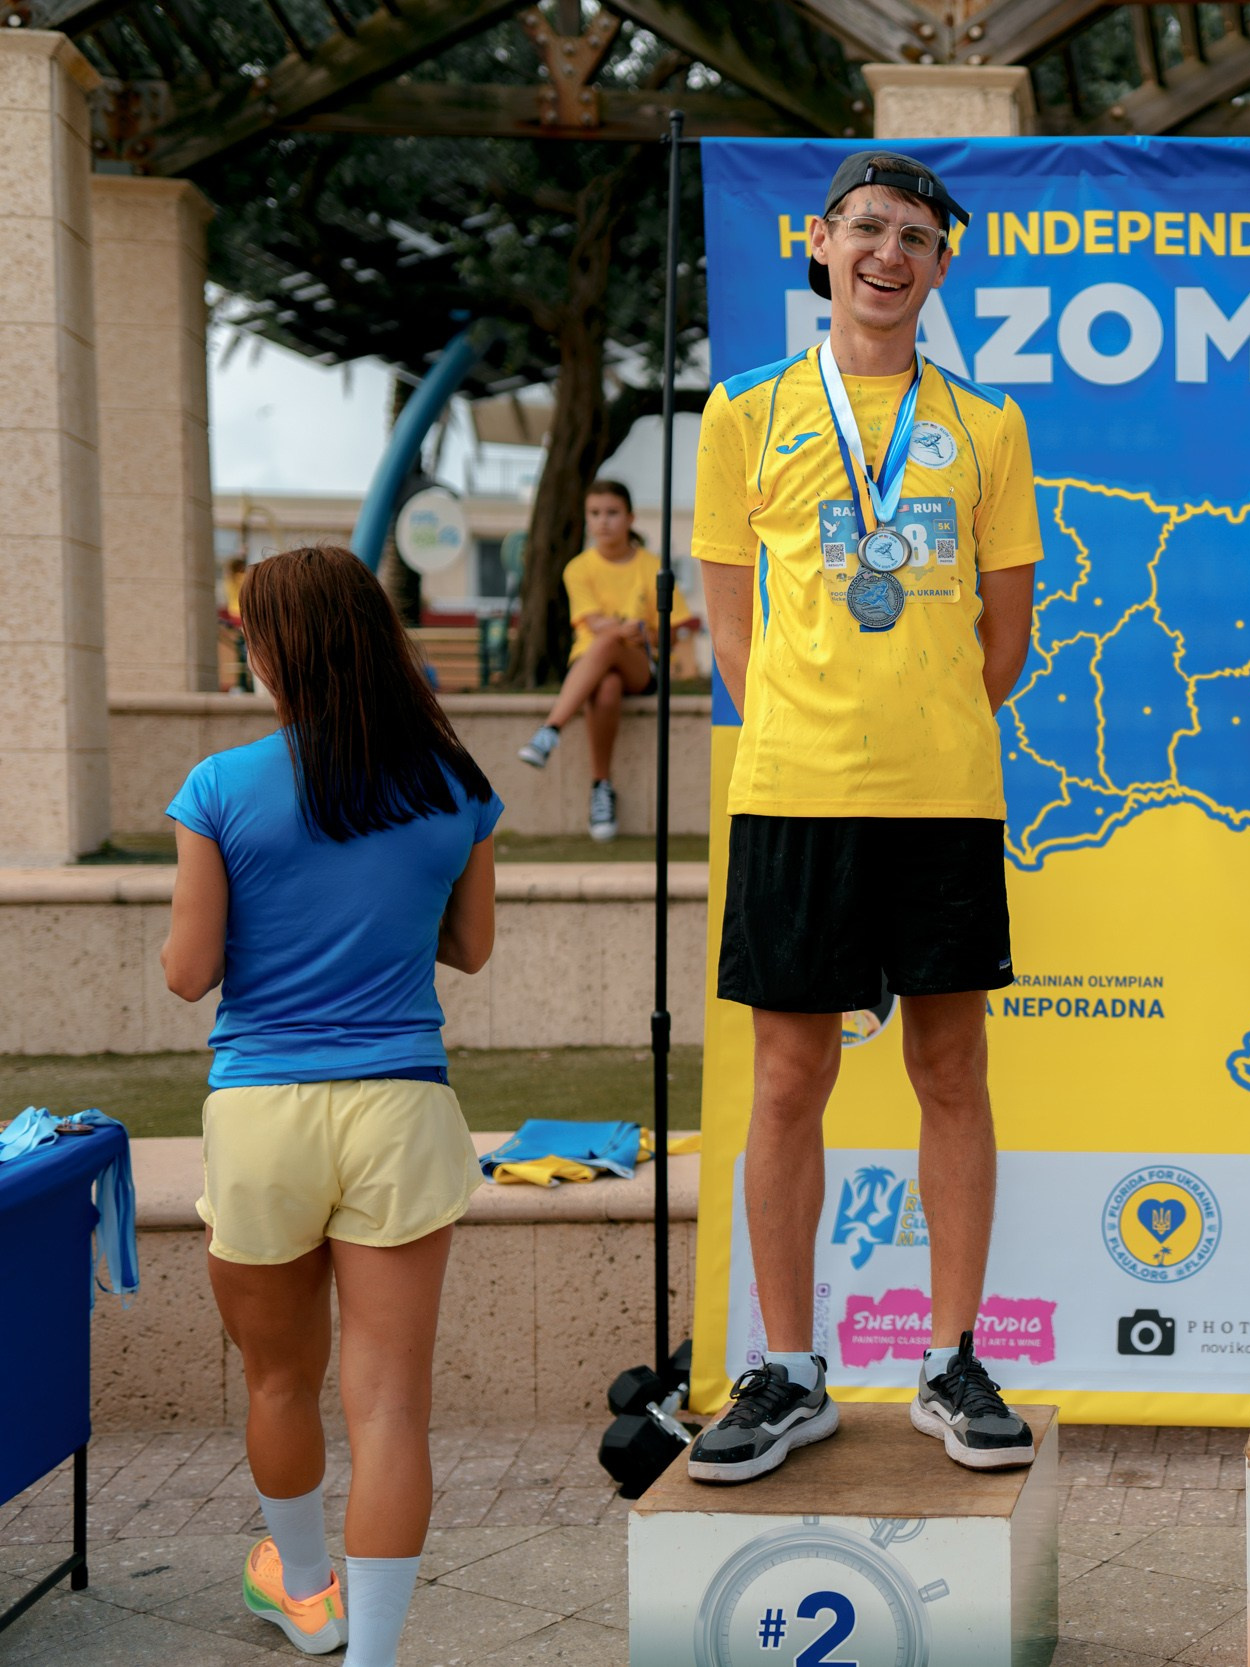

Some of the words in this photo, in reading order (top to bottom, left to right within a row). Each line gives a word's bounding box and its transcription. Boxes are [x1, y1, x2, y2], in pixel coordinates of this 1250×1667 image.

[913, 503, 942, 513] RUN
[938, 522, 951, 531] 5K
[917, 589, 955, 597] UKRAINI!
[1013, 975, 1083, 988] KRAINIAN
[1088, 975, 1164, 989] OLYMPIAN
[1003, 996, 1165, 1019] NEPORADNA
[1108, 1174, 1147, 1218] FLORIDA
[1147, 1169, 1174, 1180] FOR
[1176, 1173, 1216, 1219] UKRAINE
[896, 1335, 931, 1345] CLASSE
[758, 1590, 857, 1667] #2
